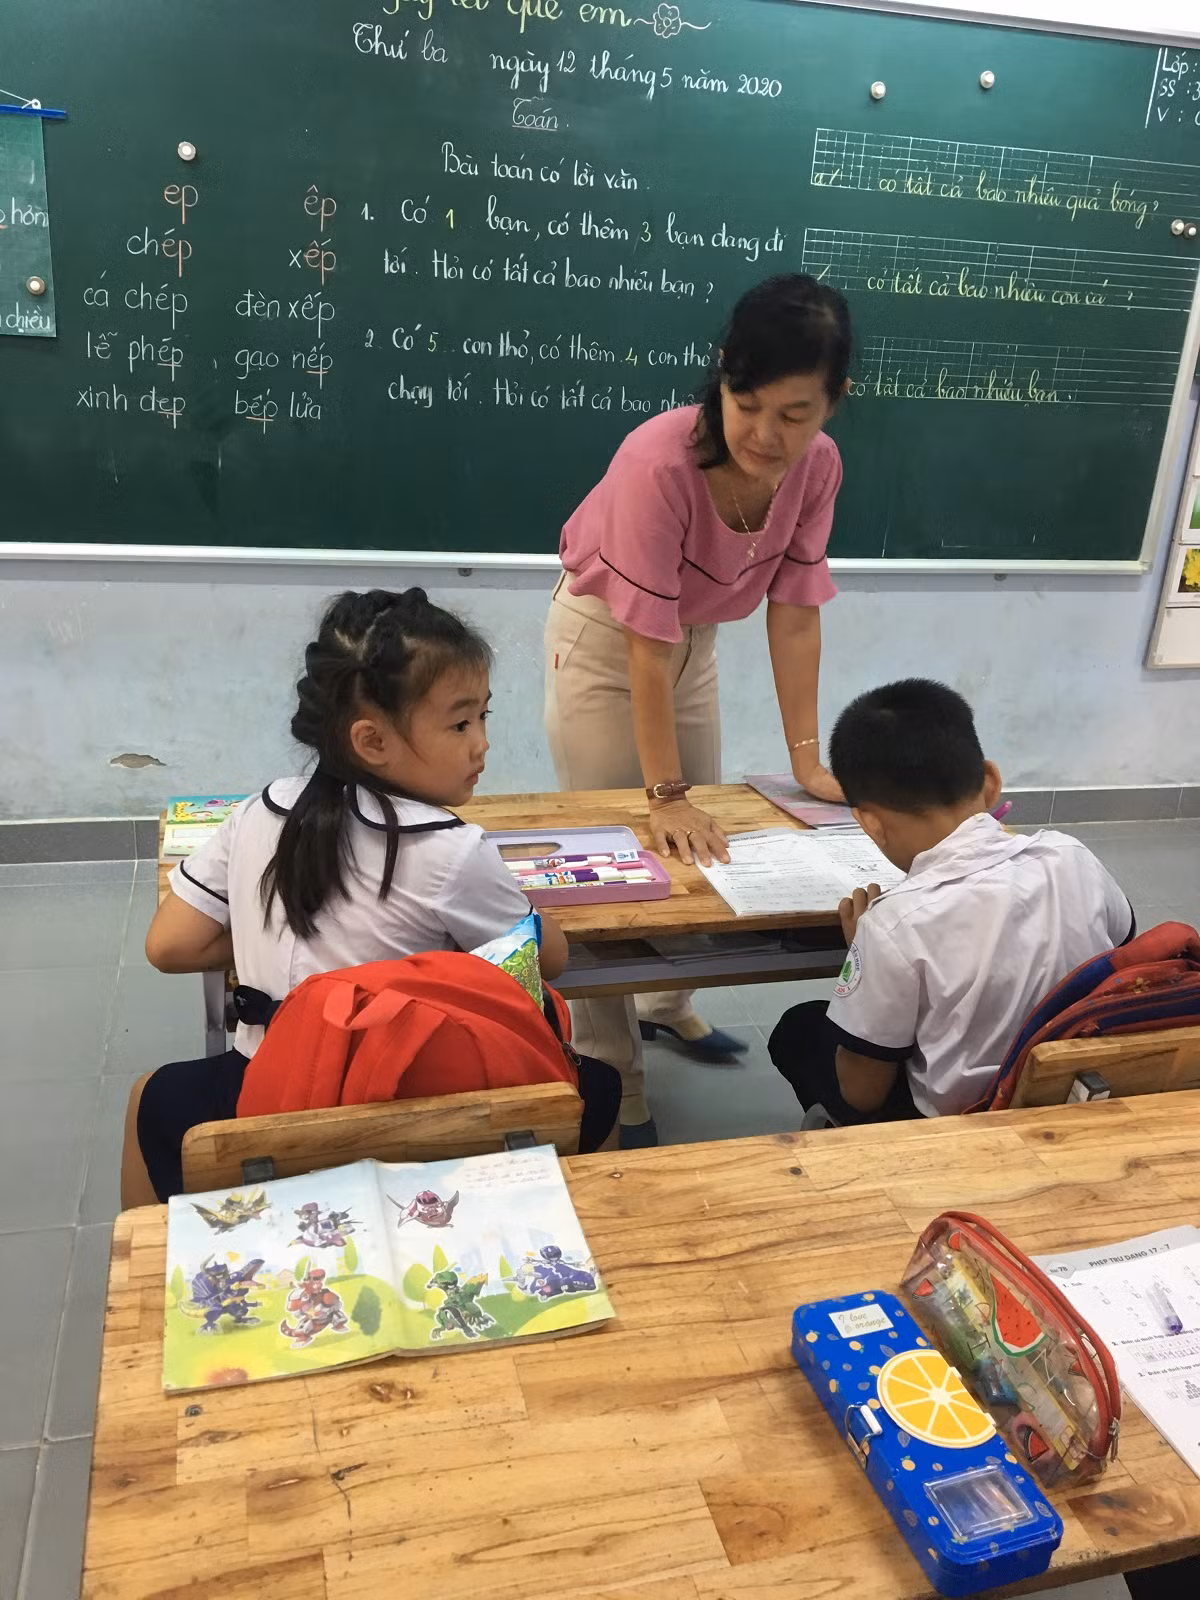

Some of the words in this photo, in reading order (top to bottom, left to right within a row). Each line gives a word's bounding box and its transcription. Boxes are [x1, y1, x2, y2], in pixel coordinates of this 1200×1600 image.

[579, 3, 632, 27] em
[352, 23, 410, 60] Thứ
[421, 29, 448, 63] ba
[489, 51, 549, 93] ngày
[556, 50, 576, 73] 12
[590, 50, 656, 100] tháng
[660, 67, 673, 88] 5
[681, 69, 729, 93] năm
[737, 73, 783, 97] 2020
[441, 142, 479, 175] Bài
[491, 153, 533, 181] toán
[540, 157, 565, 183] có
[573, 160, 595, 187] lời
[164, 184, 198, 225] ep
[304, 184, 337, 233] êp
[879, 169, 900, 192] có
[906, 168, 933, 196] tất
[940, 174, 964, 198] cả
[976, 169, 1007, 202] bao
[1015, 174, 1062, 207] nhiêu
[1066, 188, 1102, 222] quả
[360, 202, 375, 221] 1.
[401, 195, 430, 224] Có
[445, 208, 454, 229] 1
[548, 211, 570, 236] có
[580, 210, 629, 241] thêm
[640, 221, 652, 243] 3
[666, 211, 705, 250] bạn
[126, 226, 192, 278] chép
[288, 238, 337, 286] xếp
[432, 249, 464, 280] Hỏi
[472, 258, 495, 281] có
[503, 253, 530, 283] tất
[533, 260, 558, 287] cả
[564, 256, 602, 289] bao
[660, 268, 696, 301] bạn
[83, 269, 109, 308] cá
[124, 281, 188, 331] chép
[866, 268, 889, 290] có
[894, 267, 923, 295] tất
[929, 275, 951, 296] cả
[957, 266, 988, 299] bao
[1051, 289, 1082, 306] con
[1084, 279, 1109, 305] cá
[235, 288, 281, 319] đèn
[287, 291, 336, 339] xếp
[86, 330, 119, 360] lễ
[127, 334, 184, 383] phép
[234, 348, 280, 380] gạo
[291, 341, 334, 390] nếp
[392, 323, 422, 350] Có
[427, 331, 440, 352] 5
[462, 337, 493, 356] con
[539, 333, 562, 360] có
[569, 333, 615, 363] thêm
[624, 346, 639, 367] 4
[648, 349, 679, 366] con
[682, 341, 713, 368] thỏ
[76, 383, 128, 411] xinh
[139, 386, 186, 429] đẹp
[387, 374, 433, 408] chạy
[492, 377, 523, 406] Hỏi
[530, 385, 551, 409] có
[562, 379, 585, 410] tất
[591, 386, 613, 412] cả
[621, 385, 651, 413] bao
[874, 369, 901, 397] tất
[906, 378, 928, 398] cả
[935, 367, 966, 400] bao
[235, 388, 279, 434] bếp
[288, 391, 321, 420] lửa
[1148, 1246, 1158, 1255] 17
[855, 1317, 886, 1329] orange
